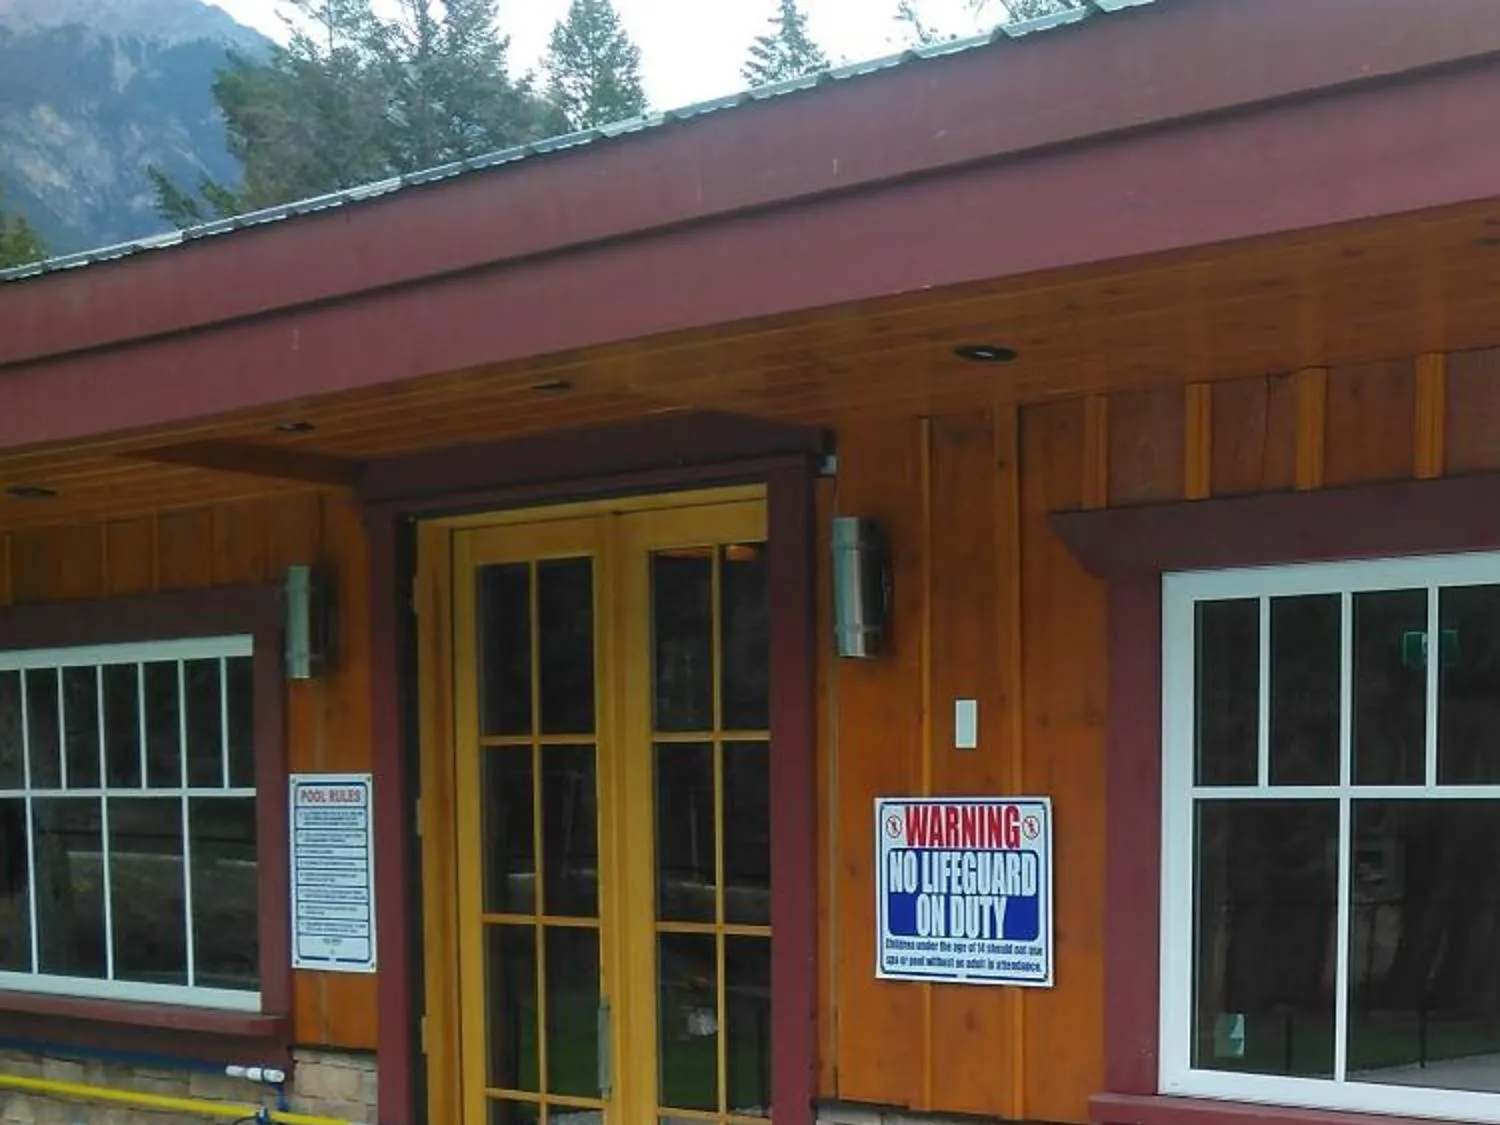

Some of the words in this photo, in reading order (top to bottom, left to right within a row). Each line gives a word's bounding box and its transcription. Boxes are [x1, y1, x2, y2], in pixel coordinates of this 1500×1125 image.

[301, 789, 326, 803] POOL
[329, 789, 361, 803] RULES
[905, 805, 1020, 849] WARNING
[889, 851, 918, 893] NO
[922, 851, 1037, 896] LIFEGUARD
[916, 893, 945, 937] ON
[951, 895, 1008, 939] DUTY
[886, 938, 915, 950] Children
[916, 939, 938, 951] under
[940, 941, 951, 953] the
[954, 943, 967, 954] age
[968, 942, 976, 953] of
[987, 943, 1013, 954] should
[909, 955, 925, 966] pool
[926, 957, 955, 967] without
[966, 958, 986, 969] adult
